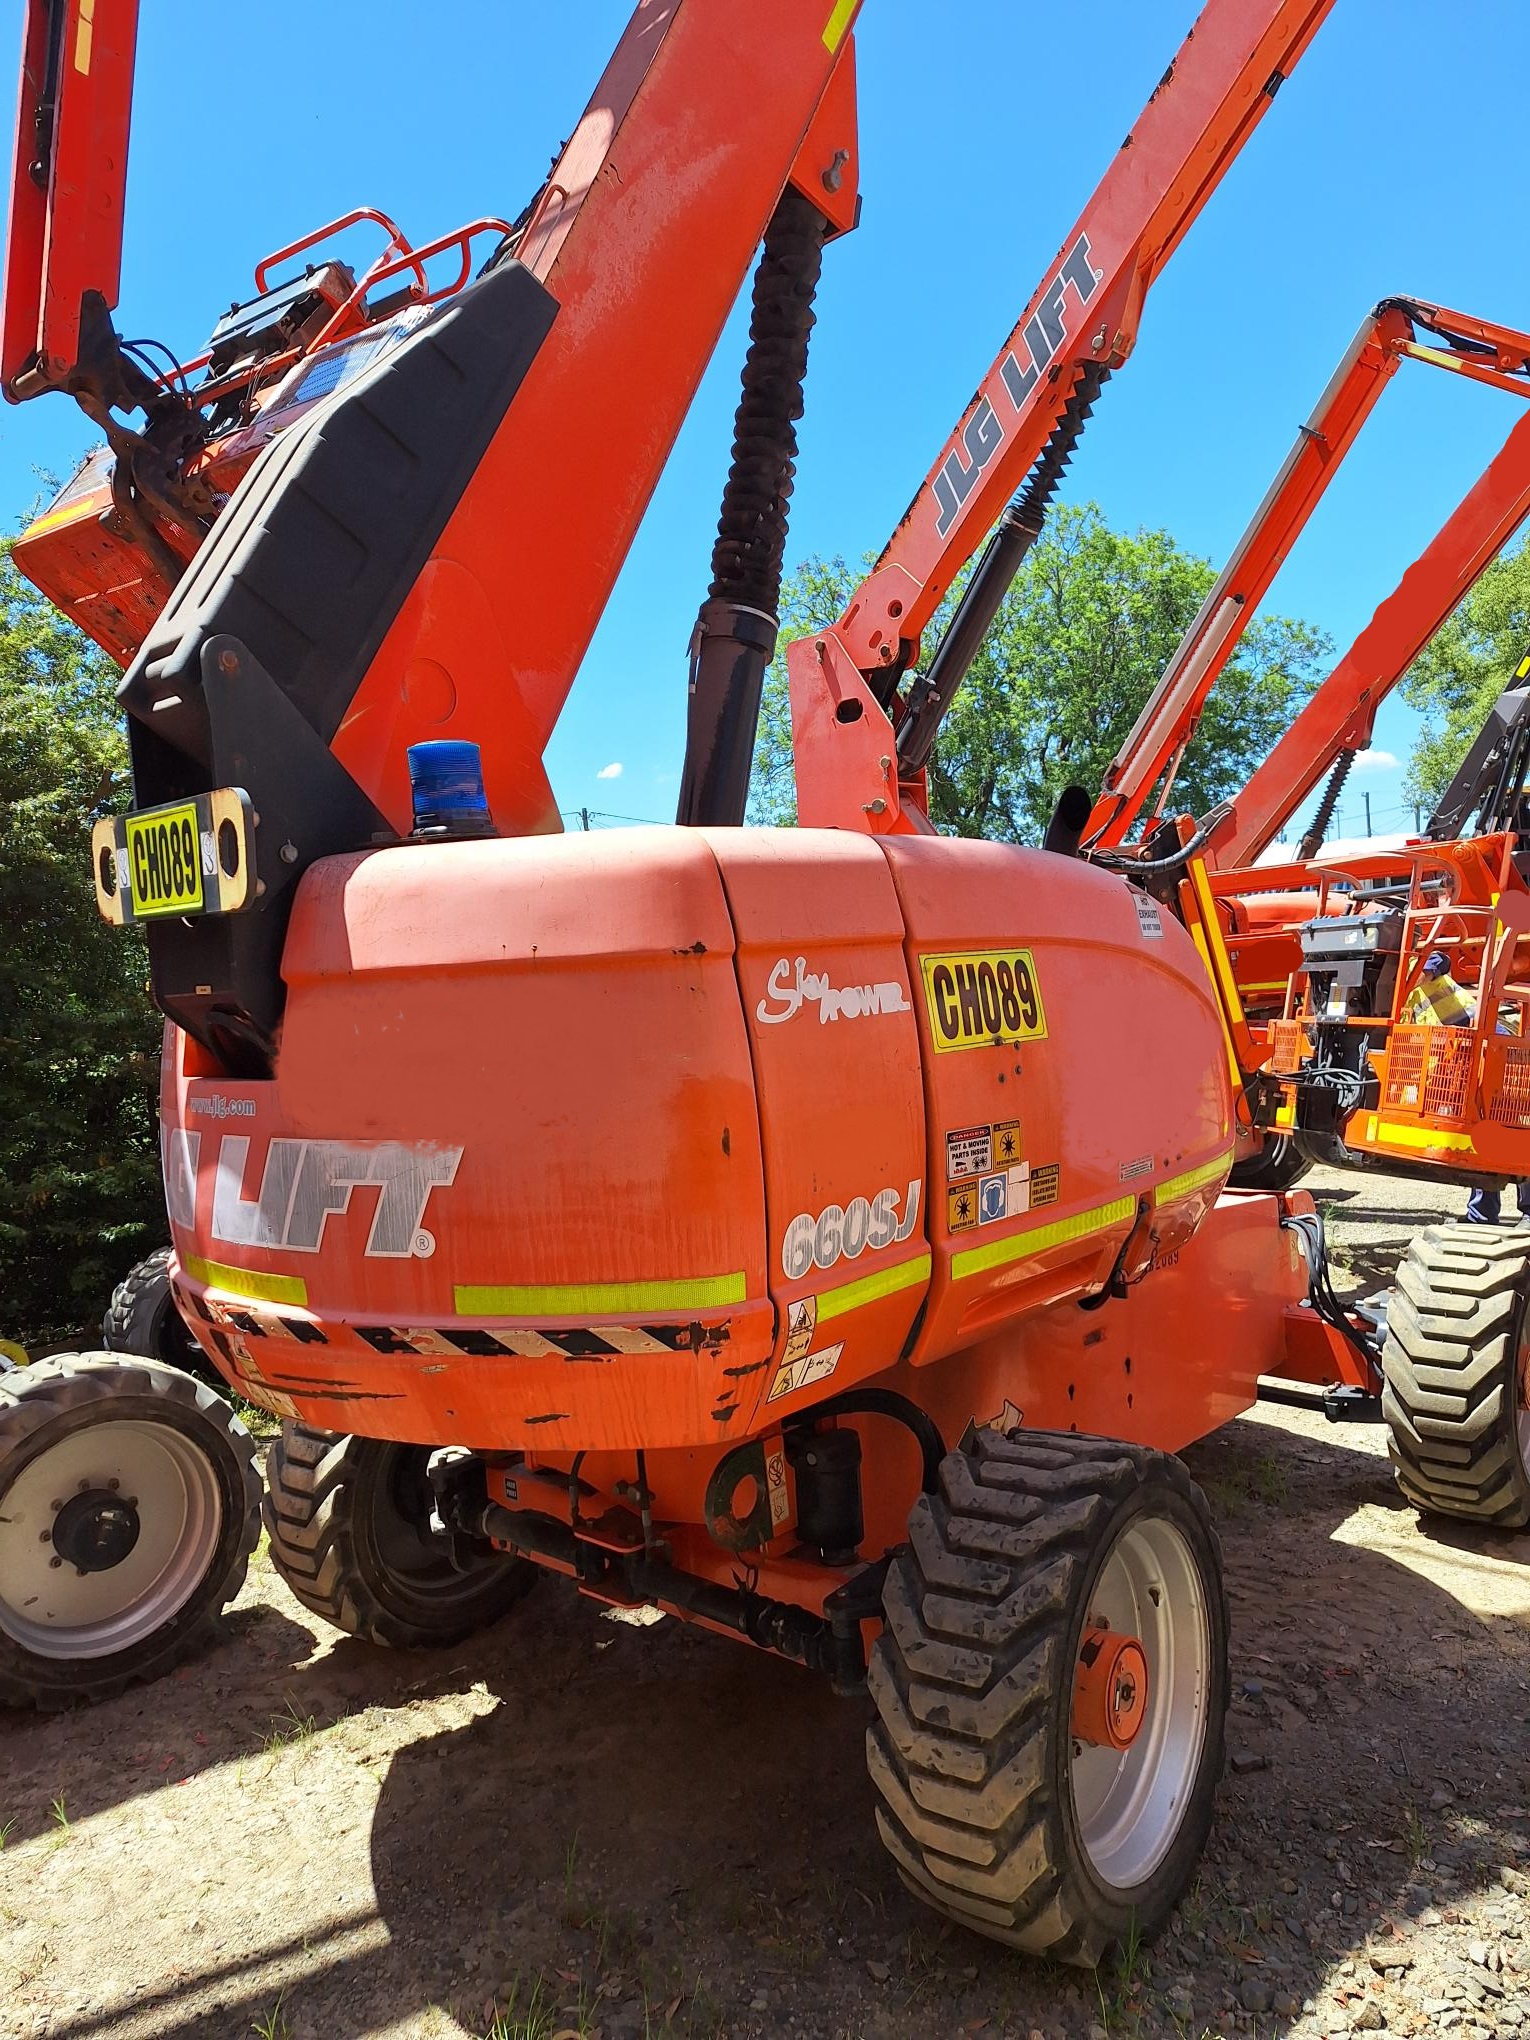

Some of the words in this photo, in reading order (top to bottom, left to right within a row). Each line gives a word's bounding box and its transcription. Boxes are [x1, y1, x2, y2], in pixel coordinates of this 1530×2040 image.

[931, 393, 1005, 541] JLG
[1000, 230, 1099, 414] LIFT
[133, 818, 197, 903] CH089
[933, 959, 1039, 1040] CH089
[189, 1094, 257, 1119] www.jlg.com
[952, 1130, 985, 1140] DANGER
[962, 1142, 968, 1150] &
[968, 1138, 989, 1148] MOVING
[952, 1151, 970, 1160] PARTS
[970, 1147, 988, 1156] INSIDE
[211, 1134, 466, 1258] LIFT
[781, 1178, 922, 1280] 660SJ
